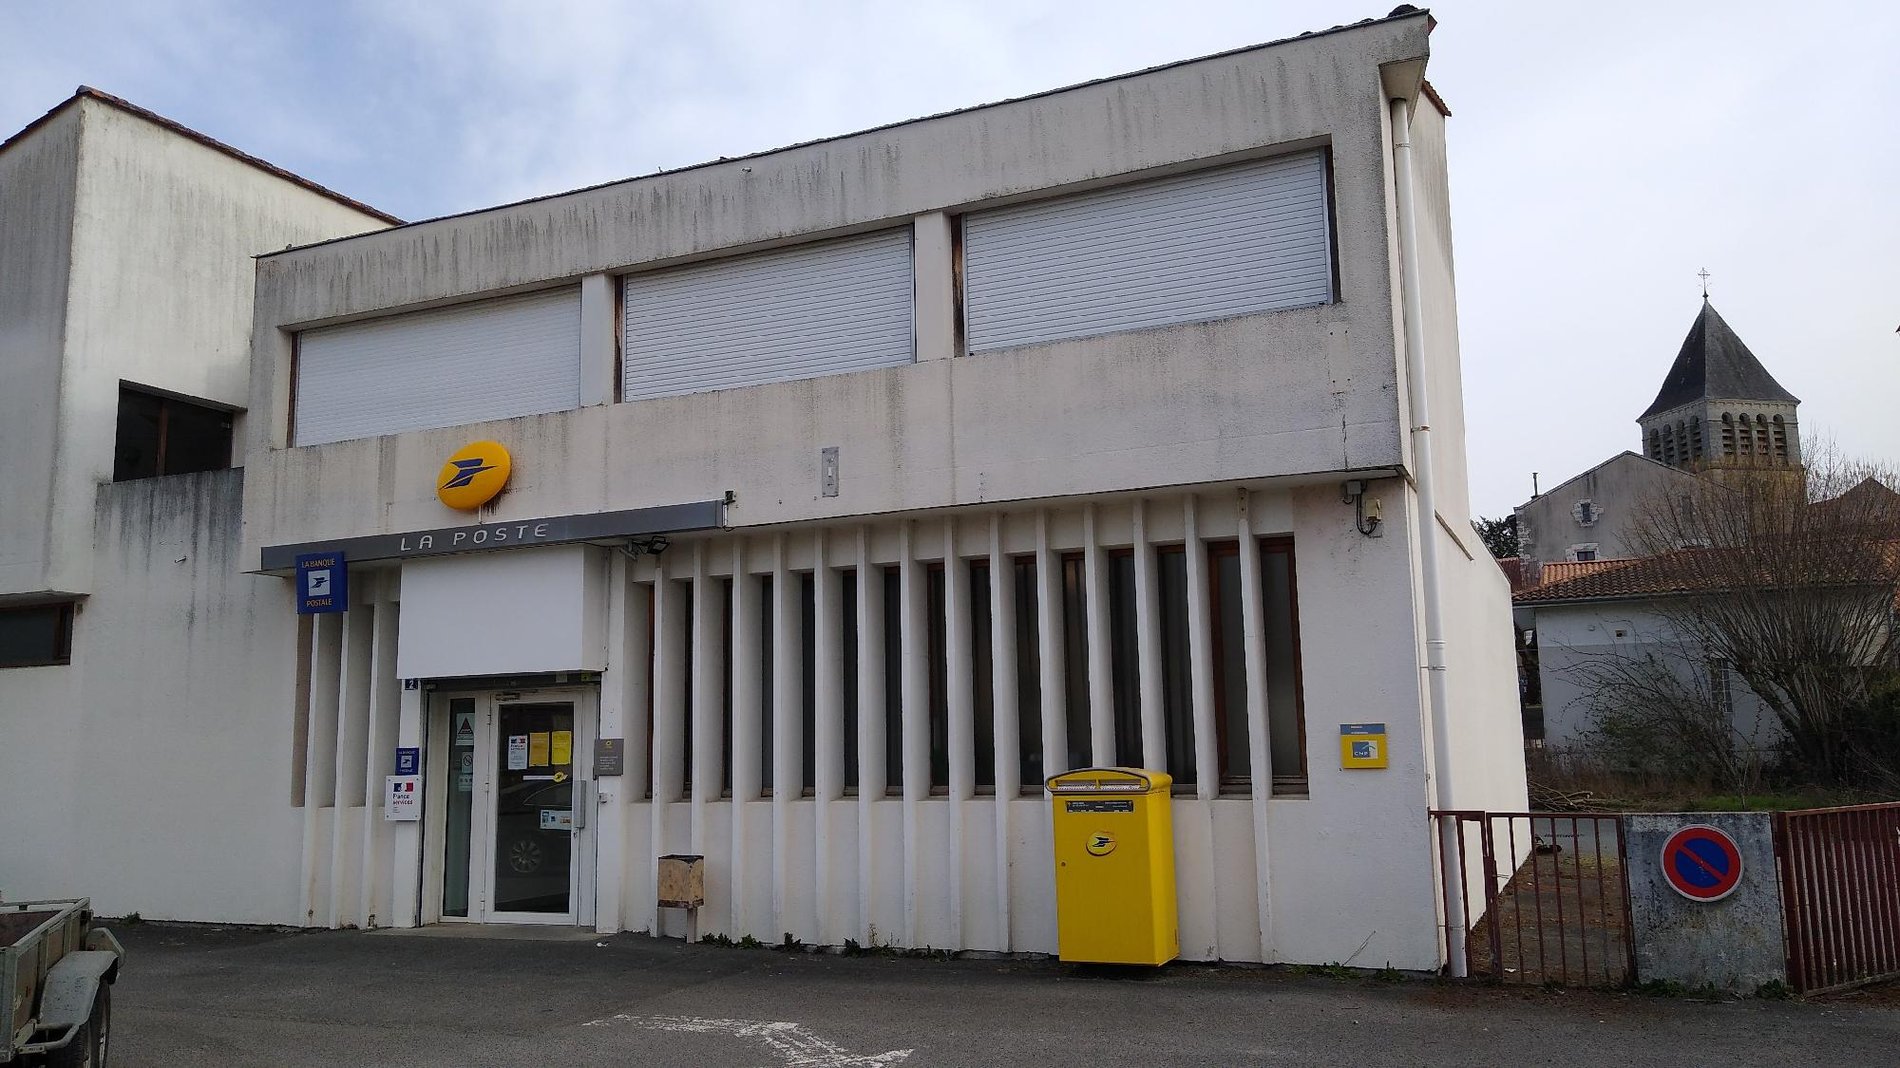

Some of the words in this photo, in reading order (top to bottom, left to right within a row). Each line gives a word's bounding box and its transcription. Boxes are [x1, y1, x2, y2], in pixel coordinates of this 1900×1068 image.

[400, 535, 433, 551] LA
[453, 523, 549, 546] POSTE
[301, 561, 310, 569] LA
[310, 558, 336, 568] BANQUE
[306, 598, 333, 608] POSTALE
